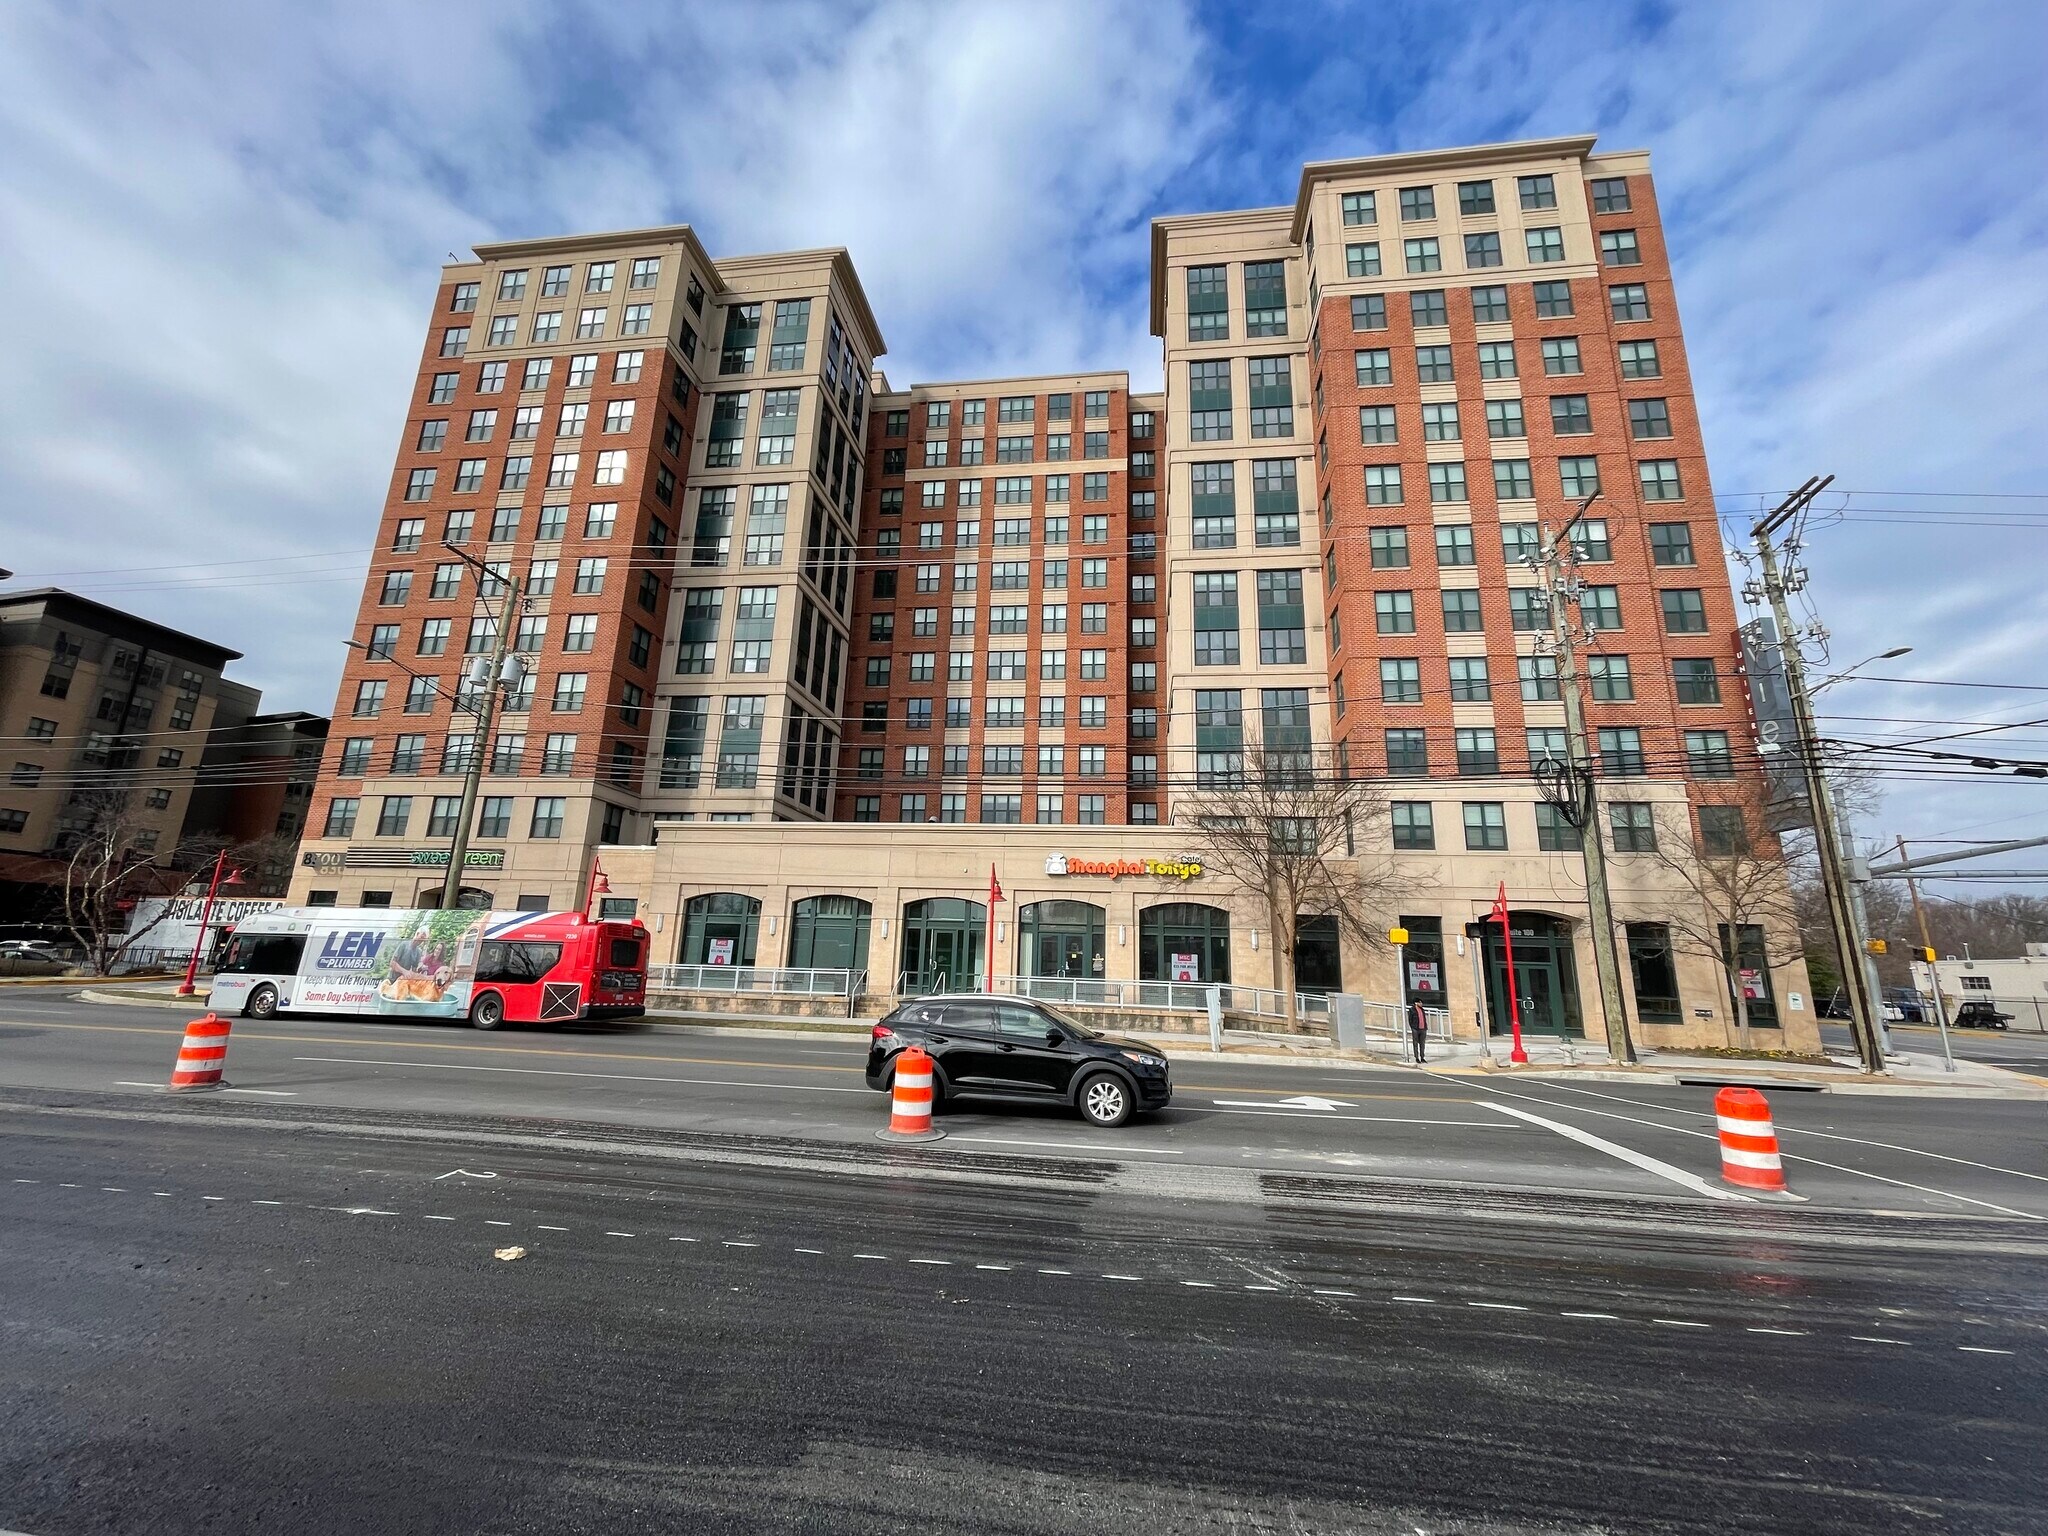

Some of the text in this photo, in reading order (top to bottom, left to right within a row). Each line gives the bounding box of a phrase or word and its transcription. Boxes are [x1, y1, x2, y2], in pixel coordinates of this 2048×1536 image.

[1736, 651, 1768, 789] UNIVERSTY
[411, 852, 500, 865] sweereen
[1066, 858, 1201, 880] Shanghai Tokyo
[167, 901, 226, 921] IGILATE
[320, 931, 386, 957] LEN
[327, 959, 374, 969] PLUMBER
[304, 974, 381, 989] Keeps Your Life Moving
[305, 991, 374, 1004] Same Day Service!
